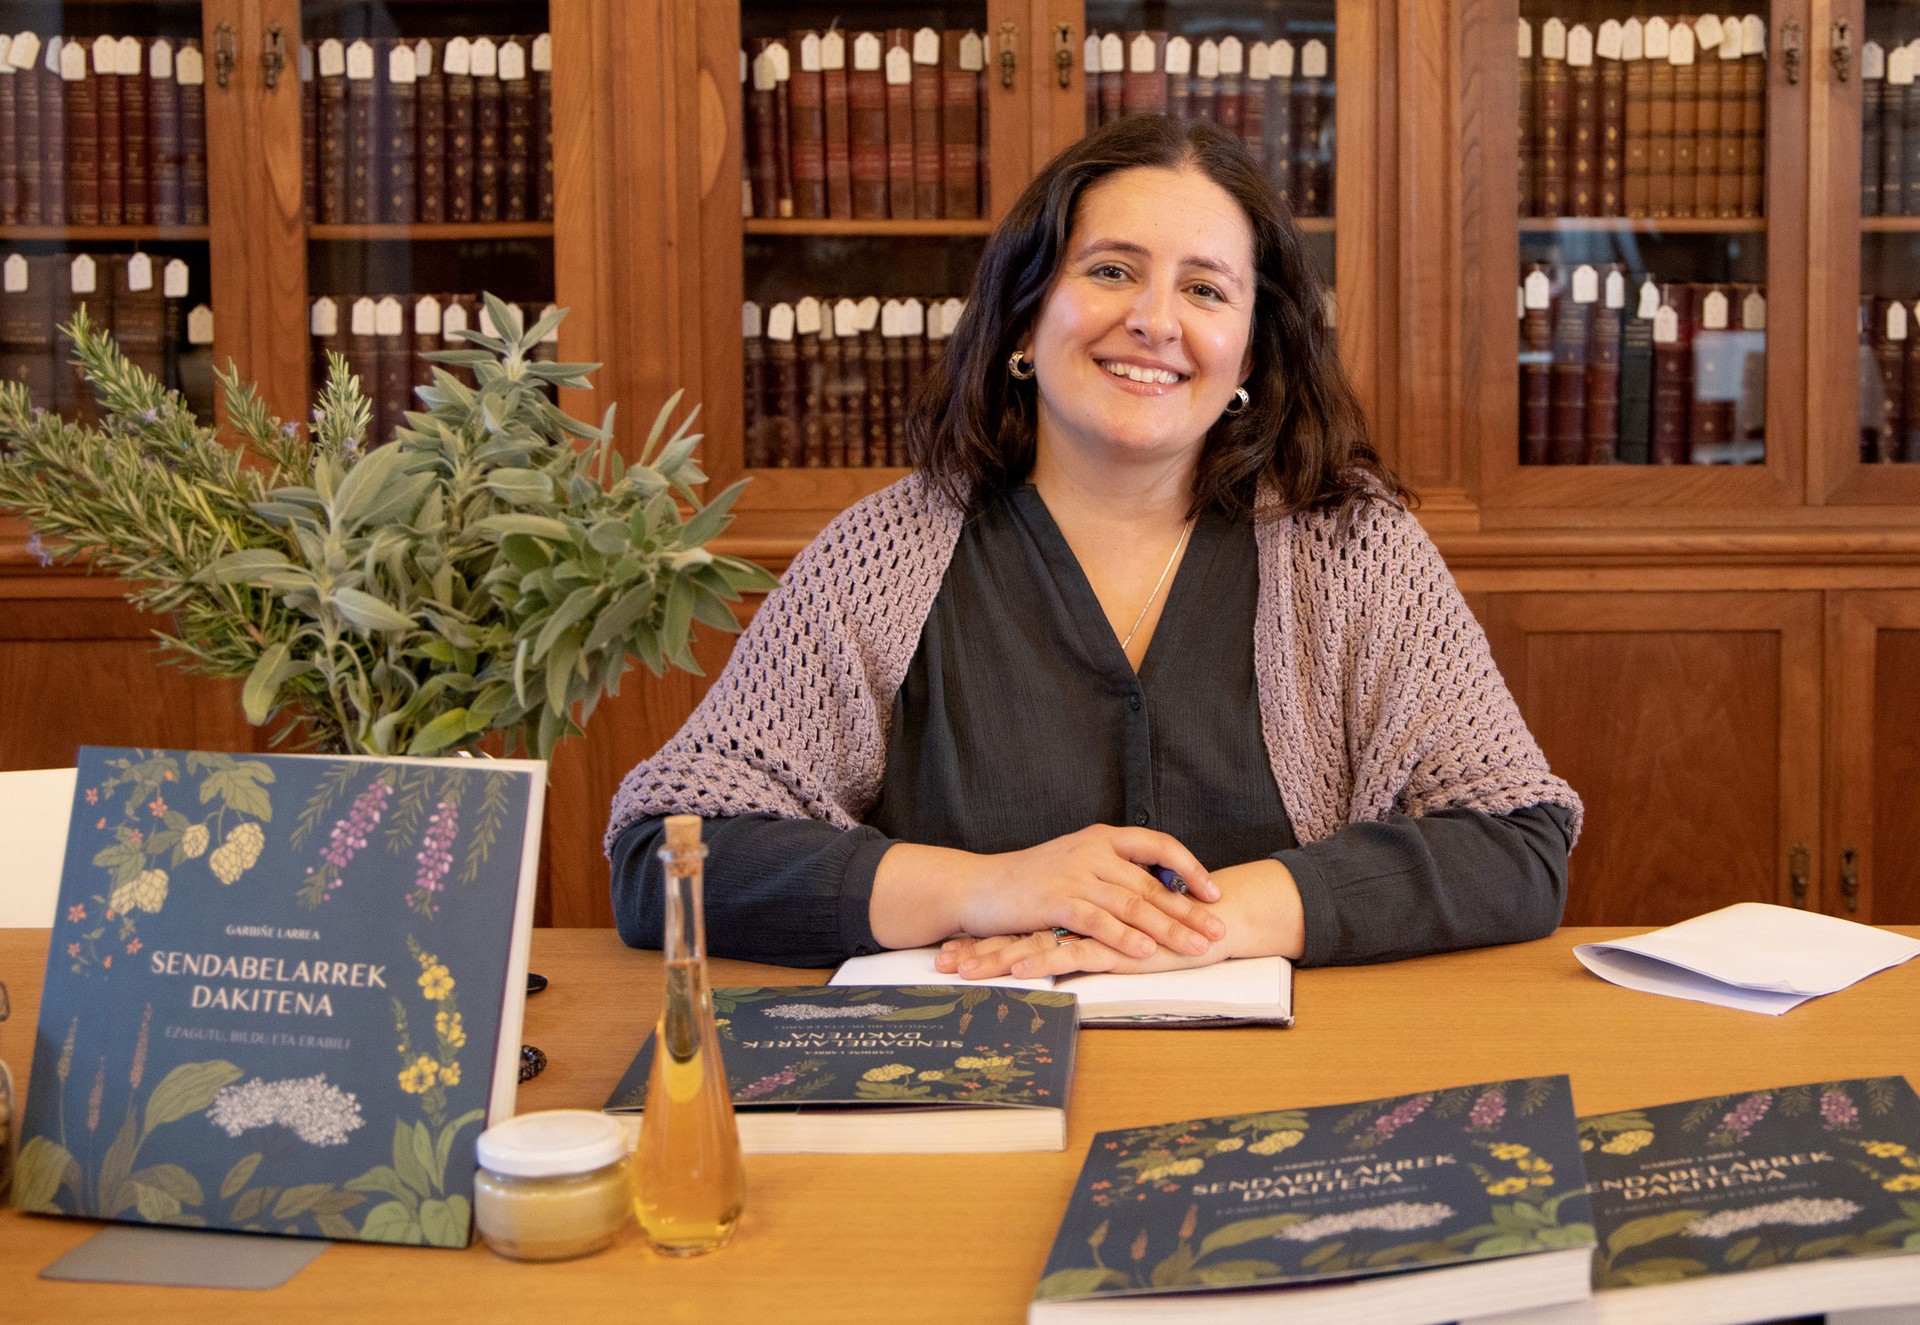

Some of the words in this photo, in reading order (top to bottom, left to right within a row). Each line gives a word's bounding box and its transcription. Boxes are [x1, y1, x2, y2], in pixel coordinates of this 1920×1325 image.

[277, 927, 320, 940] LARREA
[151, 951, 387, 988] SENDABELARREK
[191, 985, 333, 1017] DAKITENA
[742, 1040, 964, 1049] SENDABELARREK
[791, 1031, 921, 1040] DAKITENA
[1192, 1153, 1457, 1196] SENDABELARREK
[1242, 1172, 1405, 1202] DAKITENA
[1585, 1151, 1835, 1193] ENDABELARREK
[1623, 1170, 1787, 1201] DAKITENA
